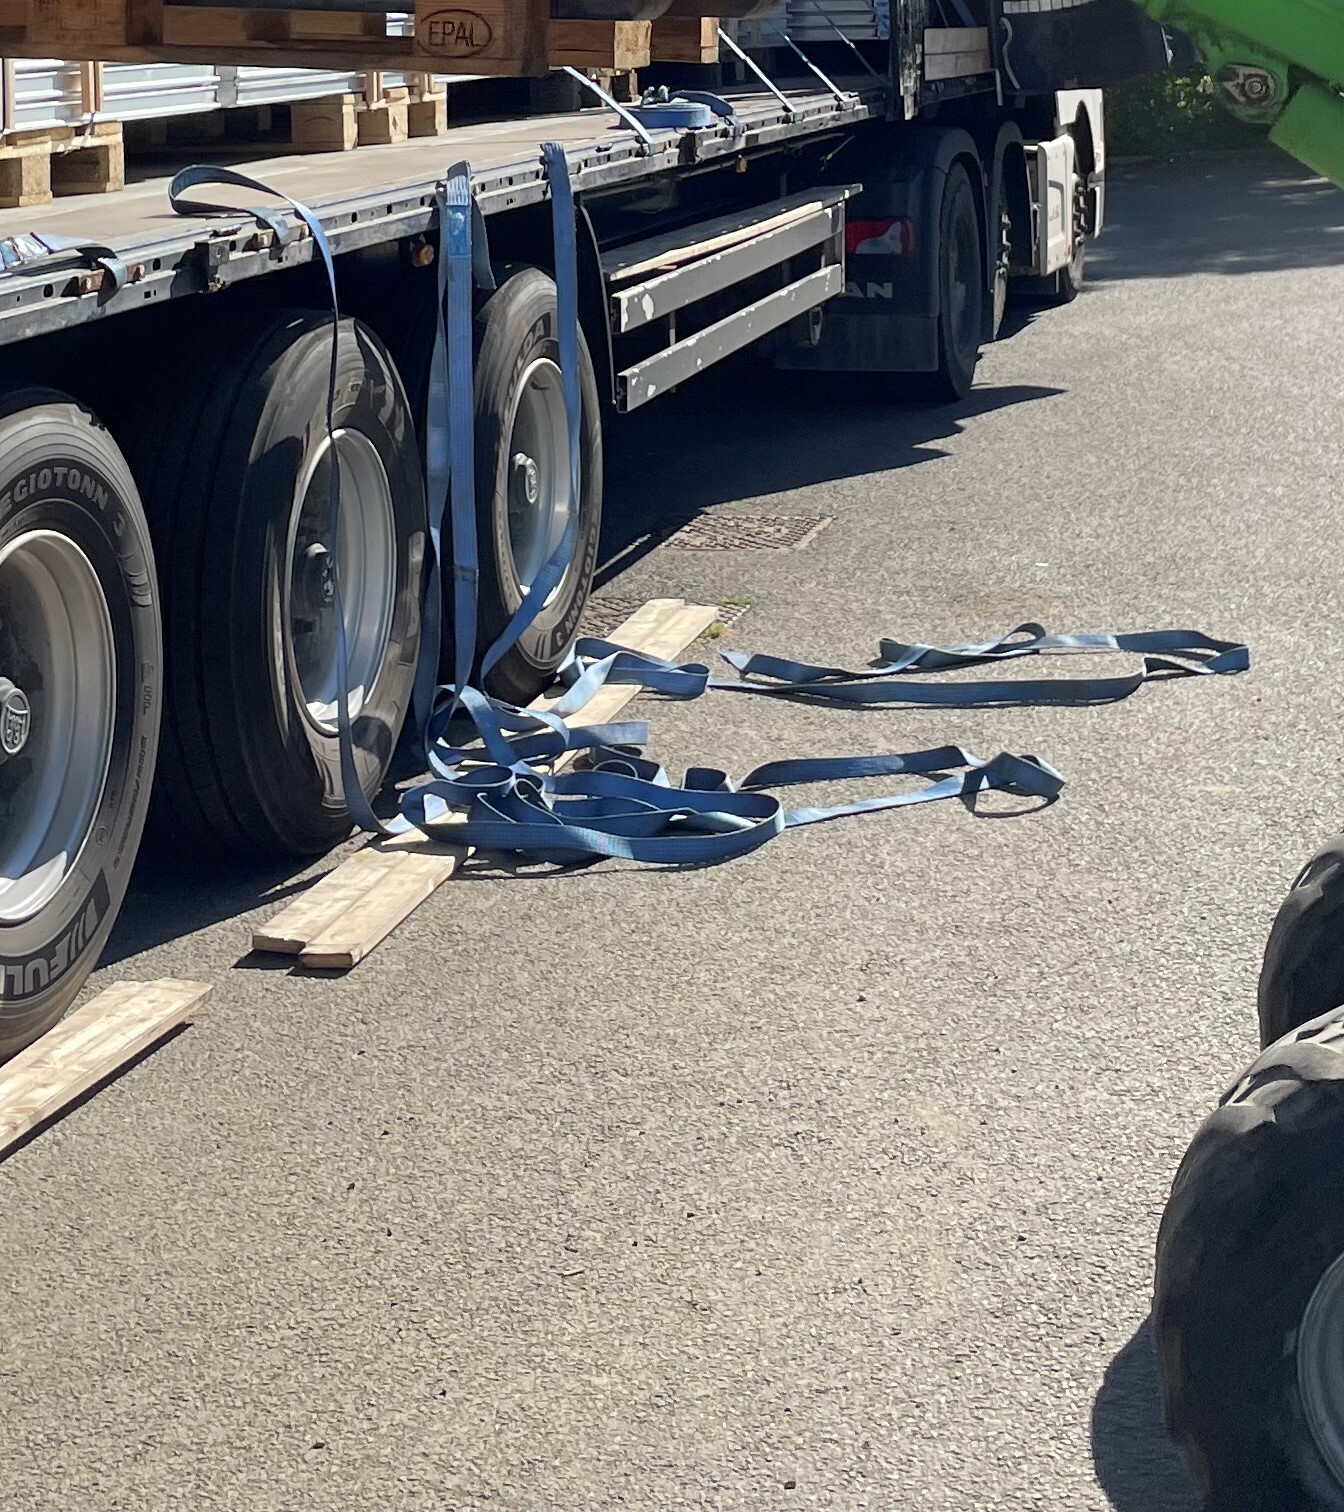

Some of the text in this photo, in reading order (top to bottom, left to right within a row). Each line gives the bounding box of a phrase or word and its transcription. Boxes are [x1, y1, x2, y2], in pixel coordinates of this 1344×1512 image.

[430, 20, 485, 47] EPAL
[844, 281, 893, 299] AN
[113, 511, 126, 537] 3
